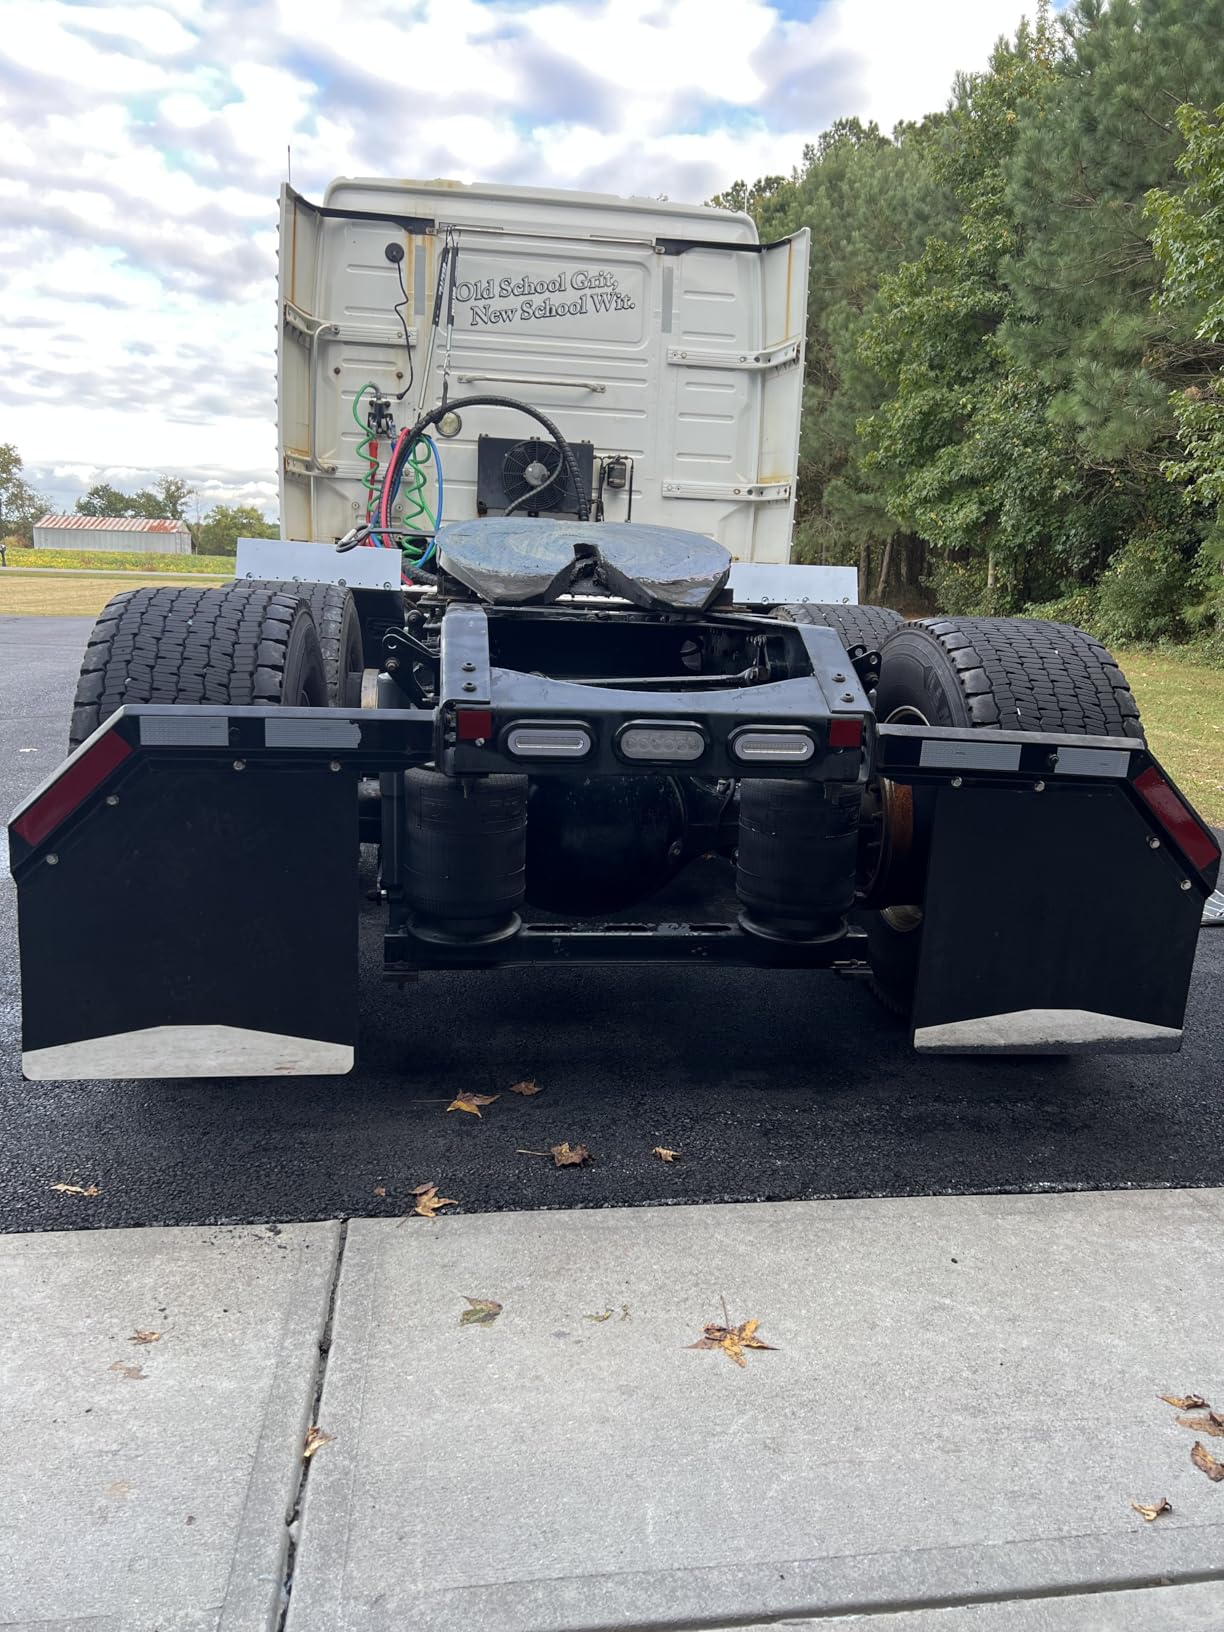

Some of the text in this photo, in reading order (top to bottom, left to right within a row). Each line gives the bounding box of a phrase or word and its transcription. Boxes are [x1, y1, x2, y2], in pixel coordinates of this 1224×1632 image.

[455, 279, 495, 302] Old
[499, 272, 566, 298] School
[570, 270, 619, 291] Grit,
[470, 291, 636, 326] New School Wit.
